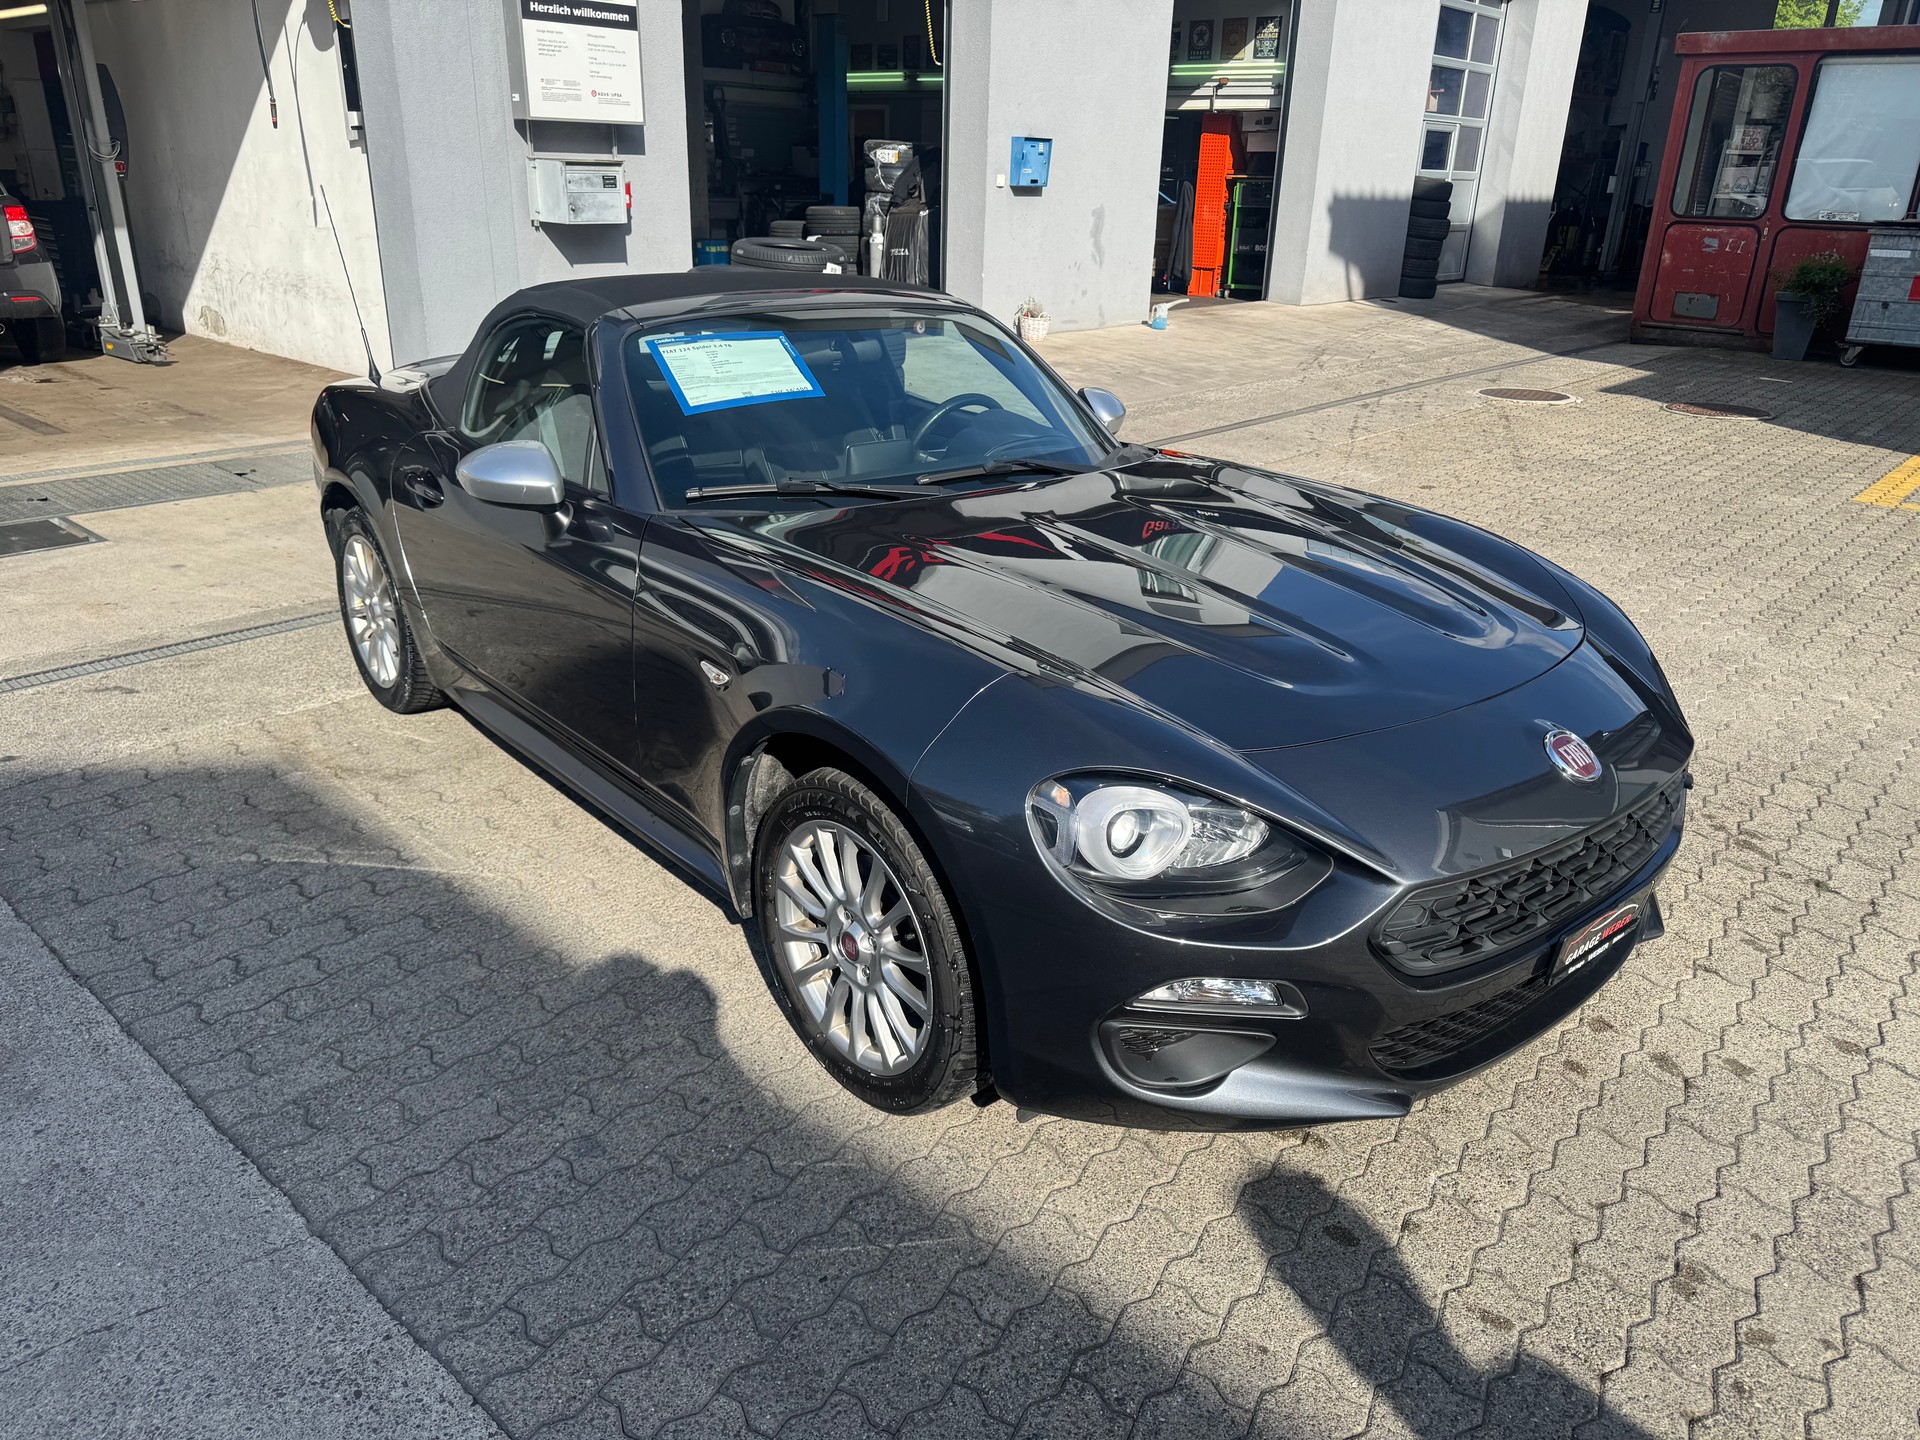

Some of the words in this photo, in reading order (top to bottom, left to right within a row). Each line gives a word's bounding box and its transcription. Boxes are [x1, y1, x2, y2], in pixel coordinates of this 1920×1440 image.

[530, 1, 571, 16] Herzlich
[572, 7, 630, 22] willkommen
[889, 248, 909, 256] TEXA
[1558, 741, 1592, 770] FIAT
[1565, 932, 1602, 965] GARAGE
